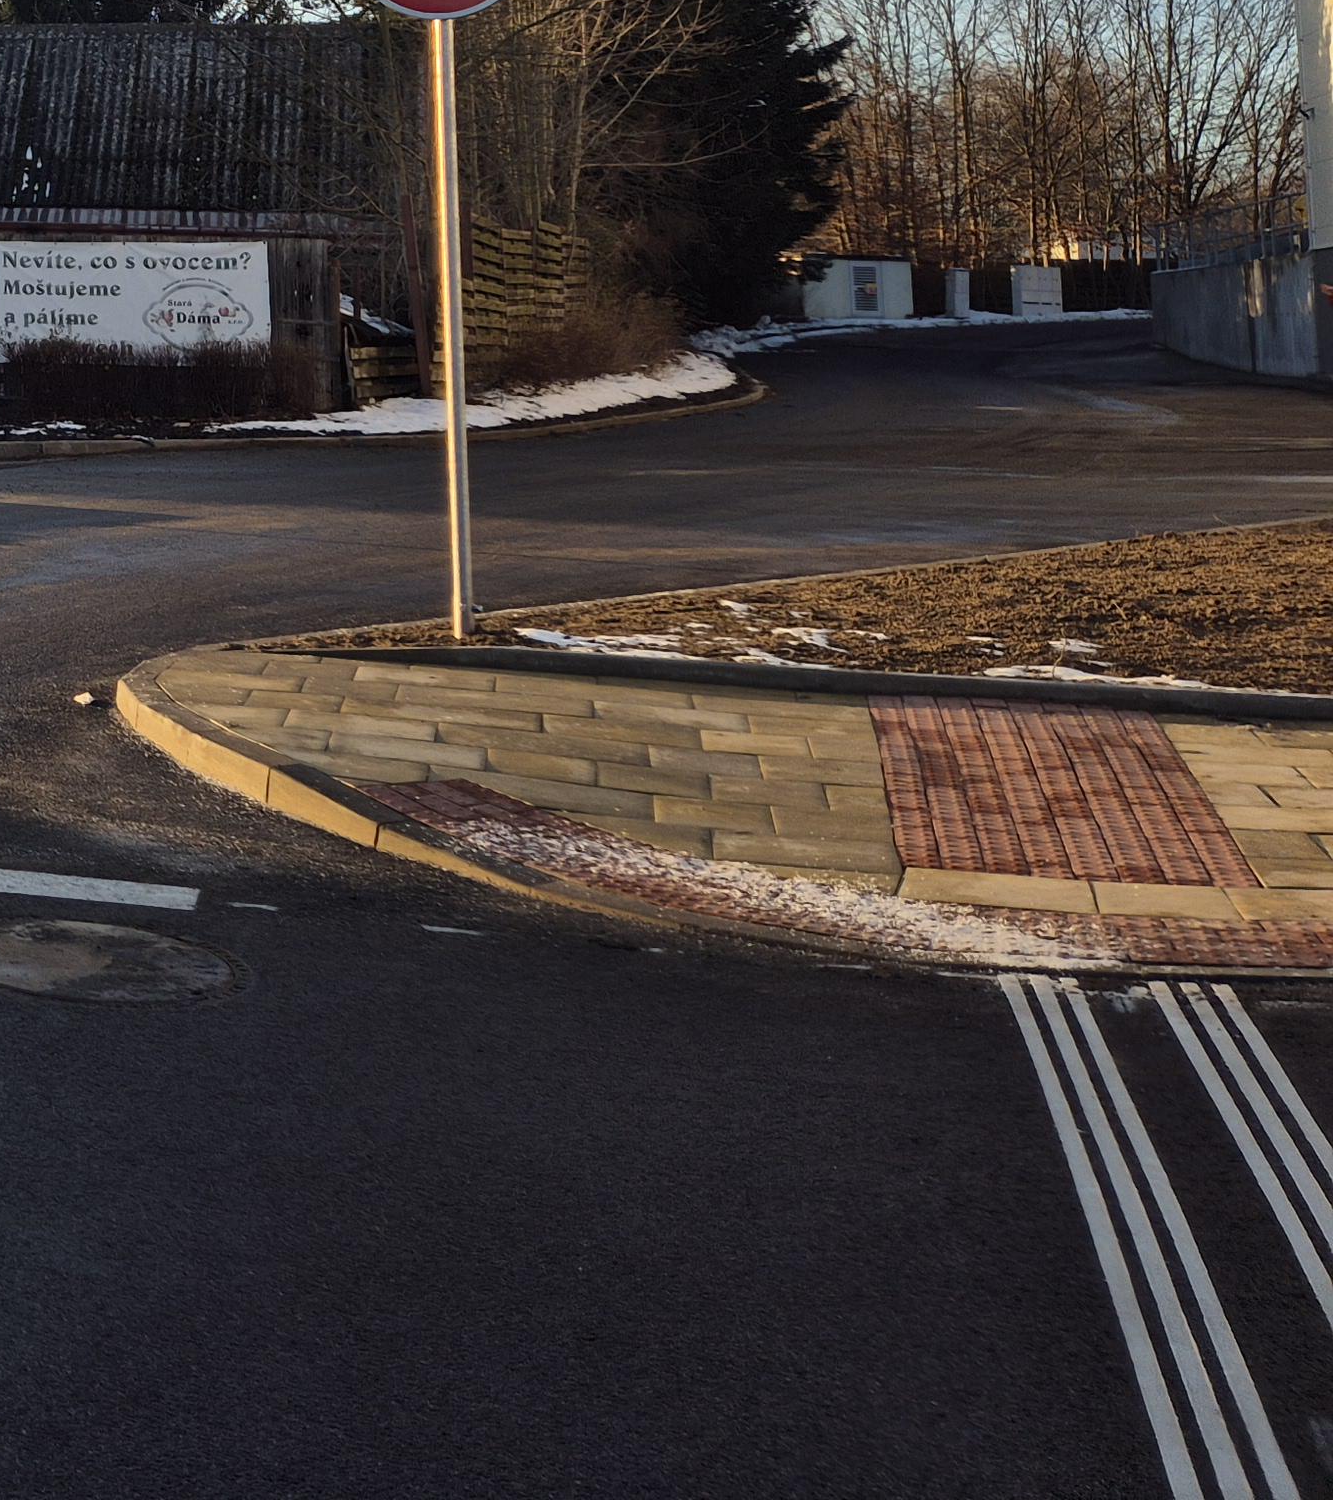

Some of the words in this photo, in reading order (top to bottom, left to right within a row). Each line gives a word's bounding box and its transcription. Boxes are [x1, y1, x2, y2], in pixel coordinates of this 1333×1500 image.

[2, 250, 83, 272] Nevíte,
[90, 255, 118, 269] co
[124, 255, 136, 269] s
[143, 251, 252, 270] ovocem?
[3, 278, 121, 299] Moštujeme
[167, 299, 192, 307] Stará
[4, 312, 16, 325] a
[24, 308, 99, 327] pálíme
[176, 311, 221, 324] Dáma
